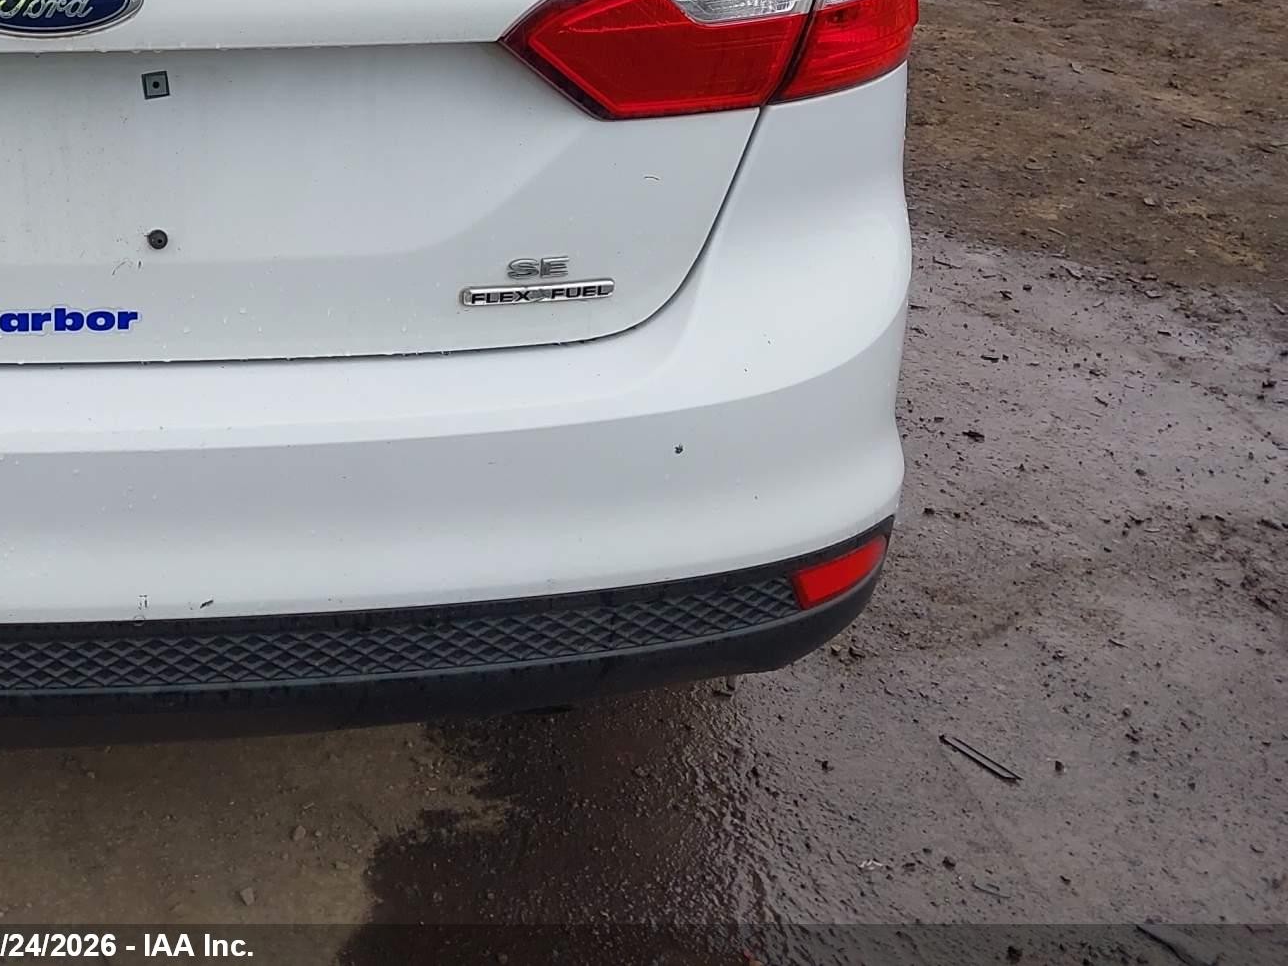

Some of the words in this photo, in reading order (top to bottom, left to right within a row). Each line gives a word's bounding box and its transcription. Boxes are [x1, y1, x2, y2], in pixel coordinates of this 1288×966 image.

[507, 255, 569, 280] SE
[471, 290, 531, 304] FLEX
[551, 285, 609, 299] FUEL
